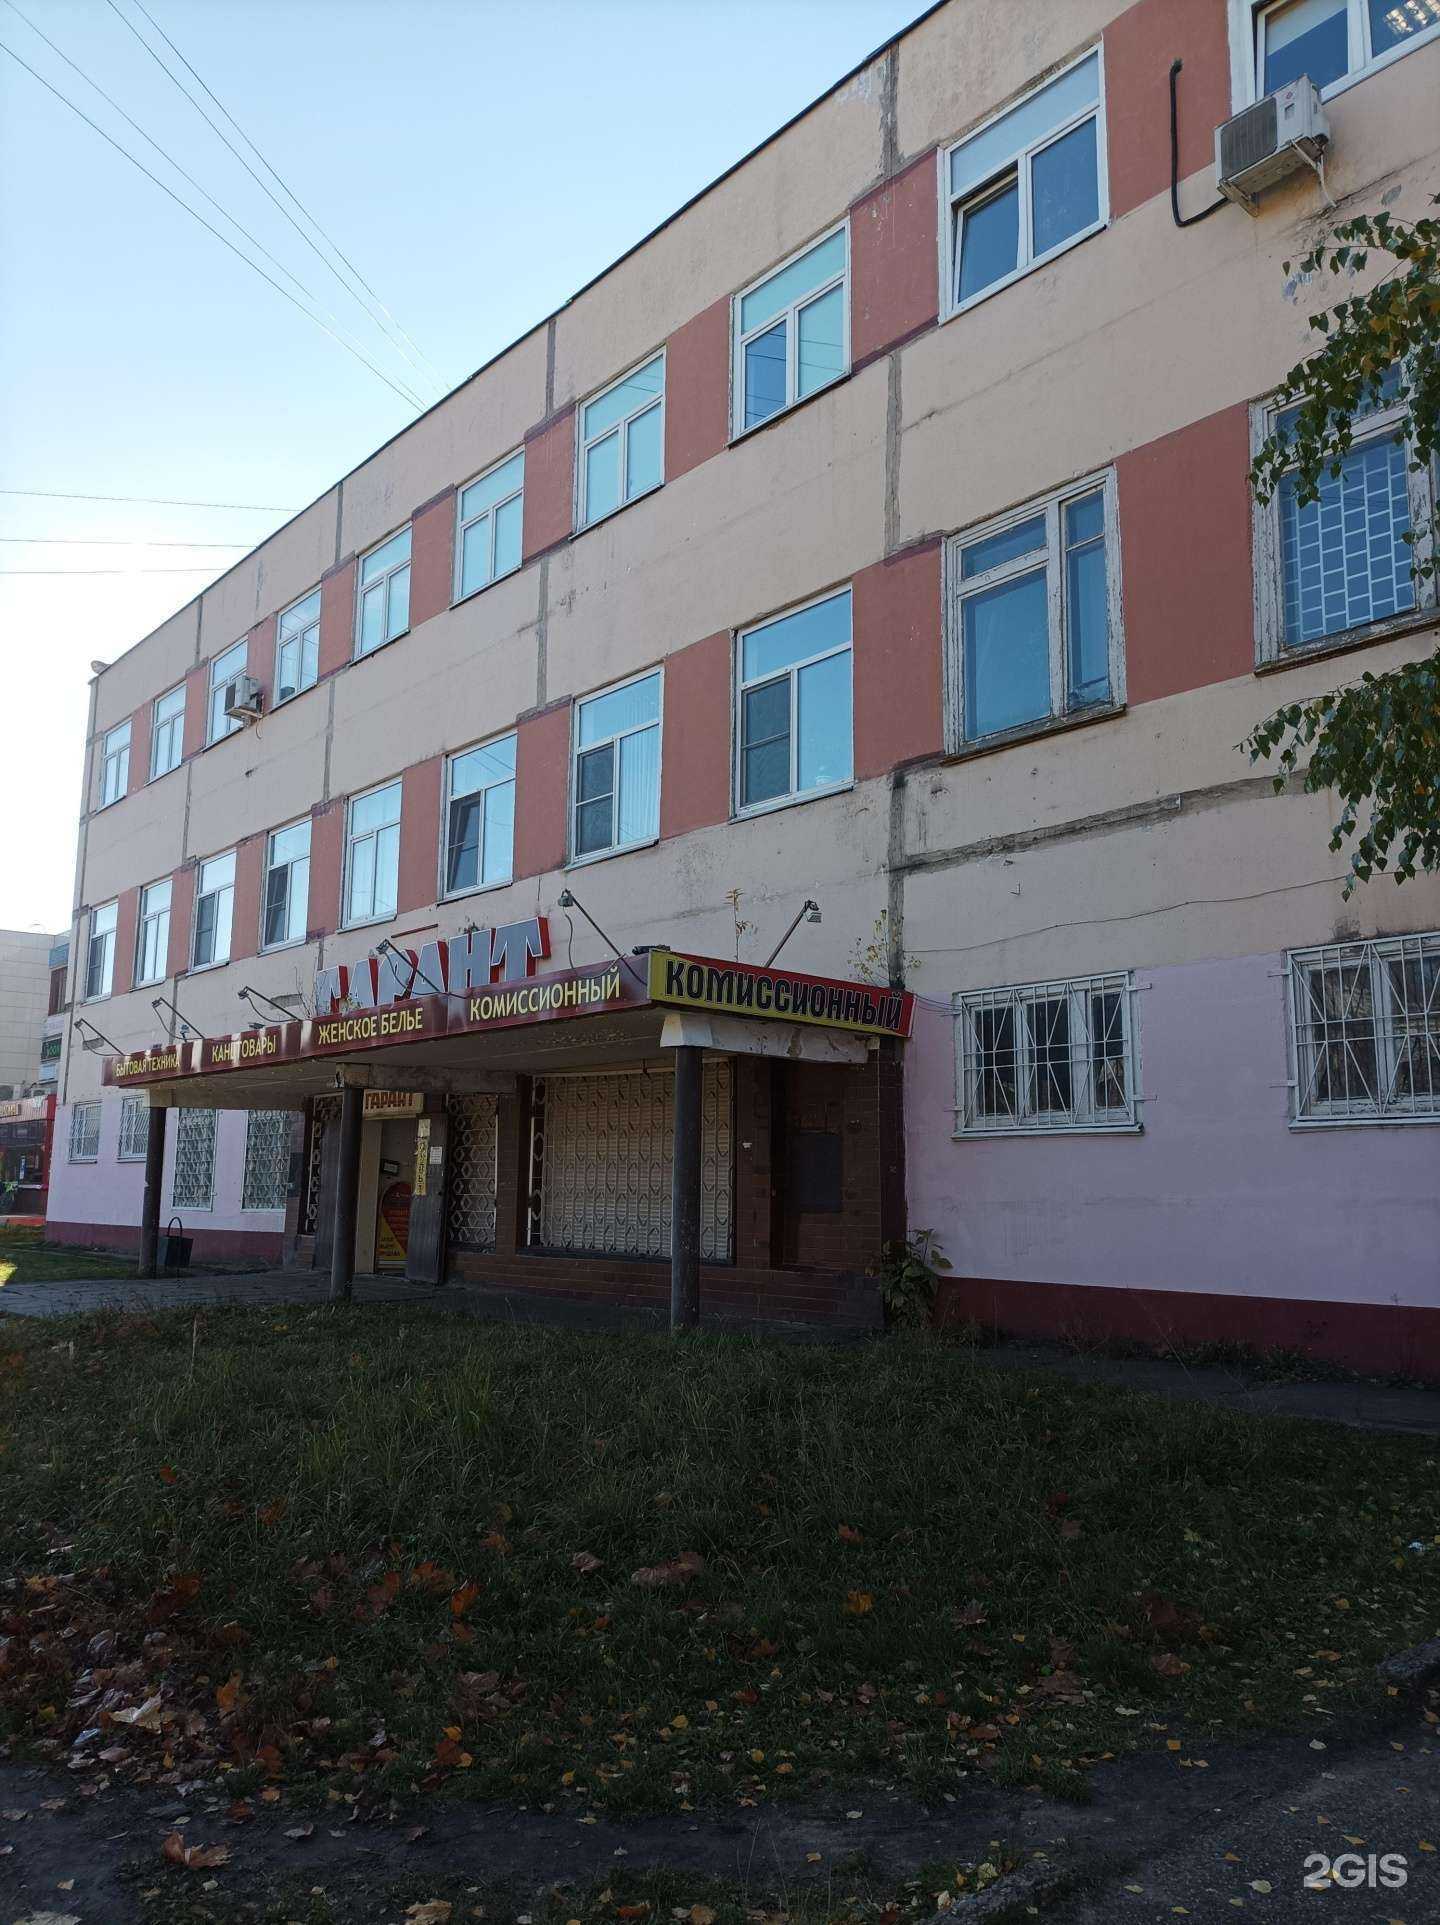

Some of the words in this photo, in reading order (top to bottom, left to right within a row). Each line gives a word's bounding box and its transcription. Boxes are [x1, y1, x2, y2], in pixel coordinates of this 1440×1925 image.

[469, 967, 621, 1022] КОМИССИОННЫЙ
[664, 957, 905, 1031] КОМИССИОННЫЙ
[318, 1015, 378, 1046] ЖЕНСКОЕ
[380, 1007, 424, 1036] БЕЛЬЕ
[115, 1057, 147, 1078] БЫТОВАЯ
[147, 1053, 180, 1073] ТЕХНИКА
[212, 1034, 277, 1063] КАНЦТОВАРЫ
